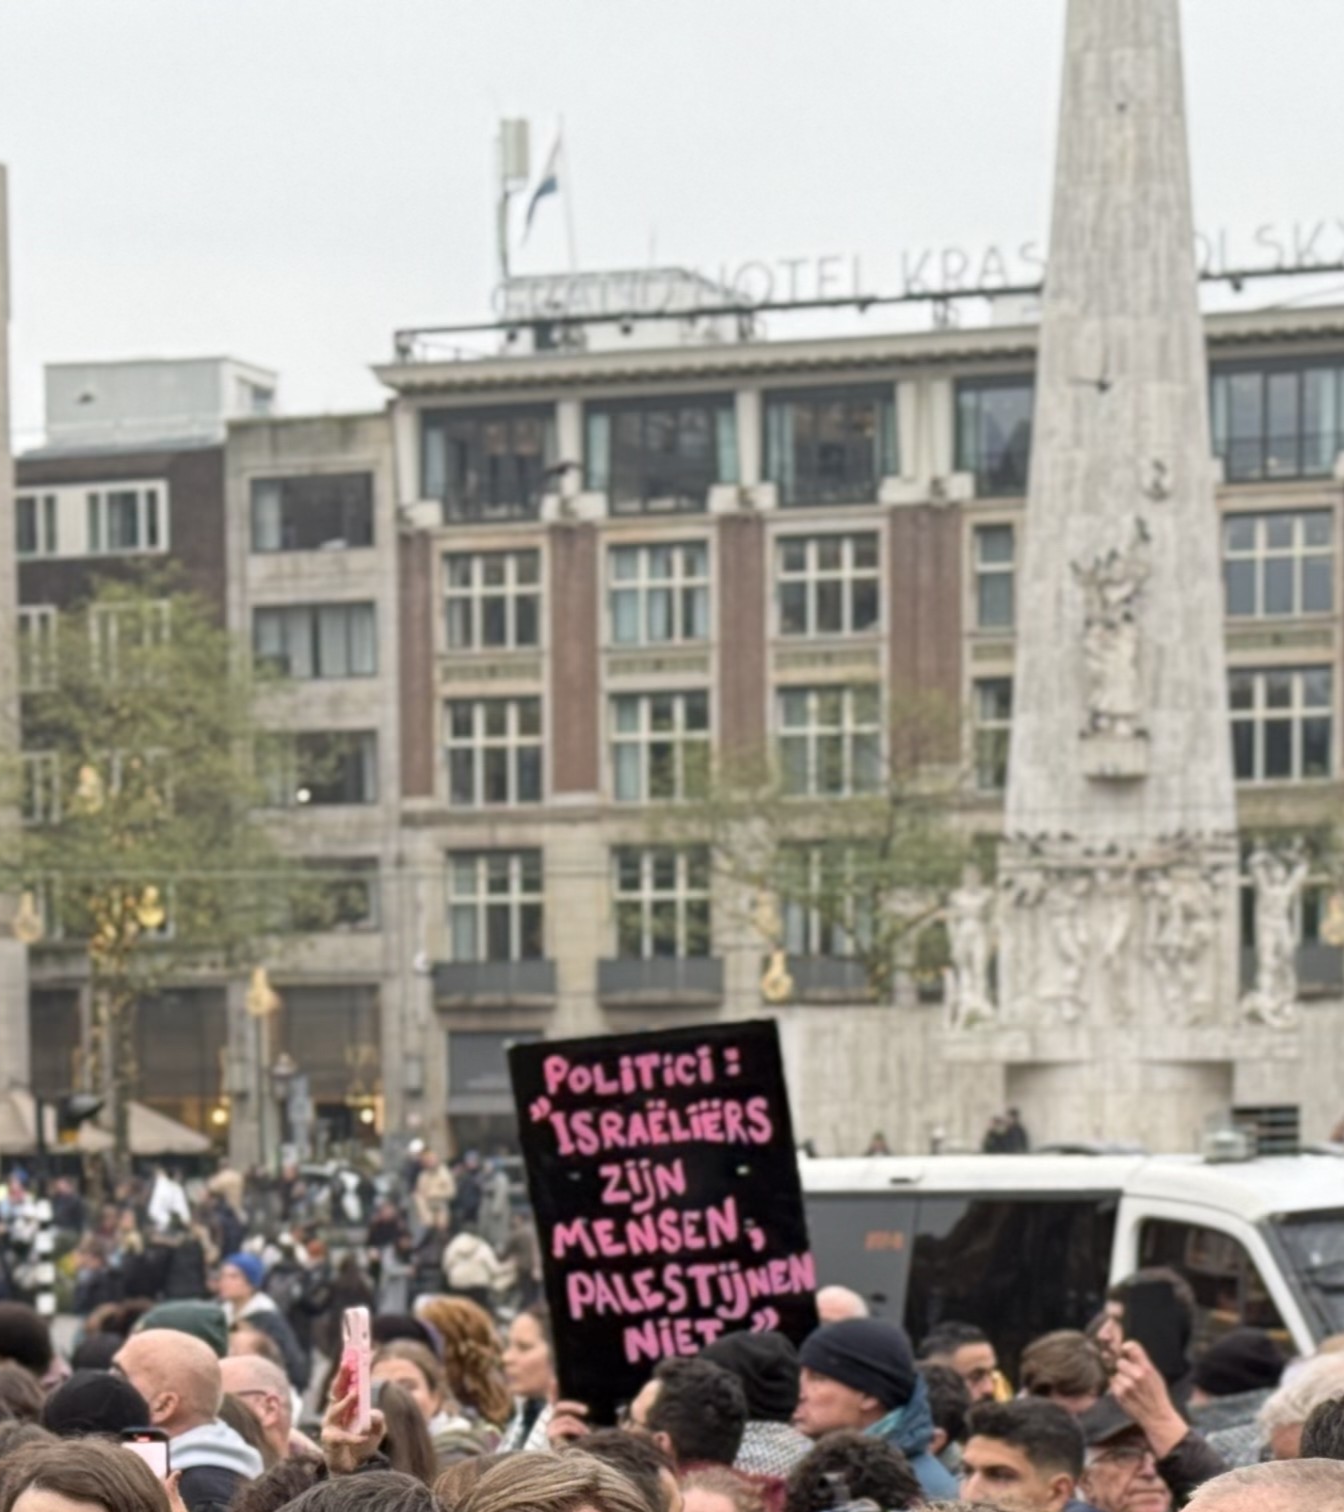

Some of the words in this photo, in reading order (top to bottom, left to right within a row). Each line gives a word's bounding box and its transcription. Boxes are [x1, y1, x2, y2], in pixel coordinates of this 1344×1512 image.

[694, 252, 868, 312] HOTEL
[599, 1159, 687, 1214] ZIJN
[553, 1197, 766, 1258] MENSEN,
[567, 1252, 817, 1320] PALESTIJNEN
